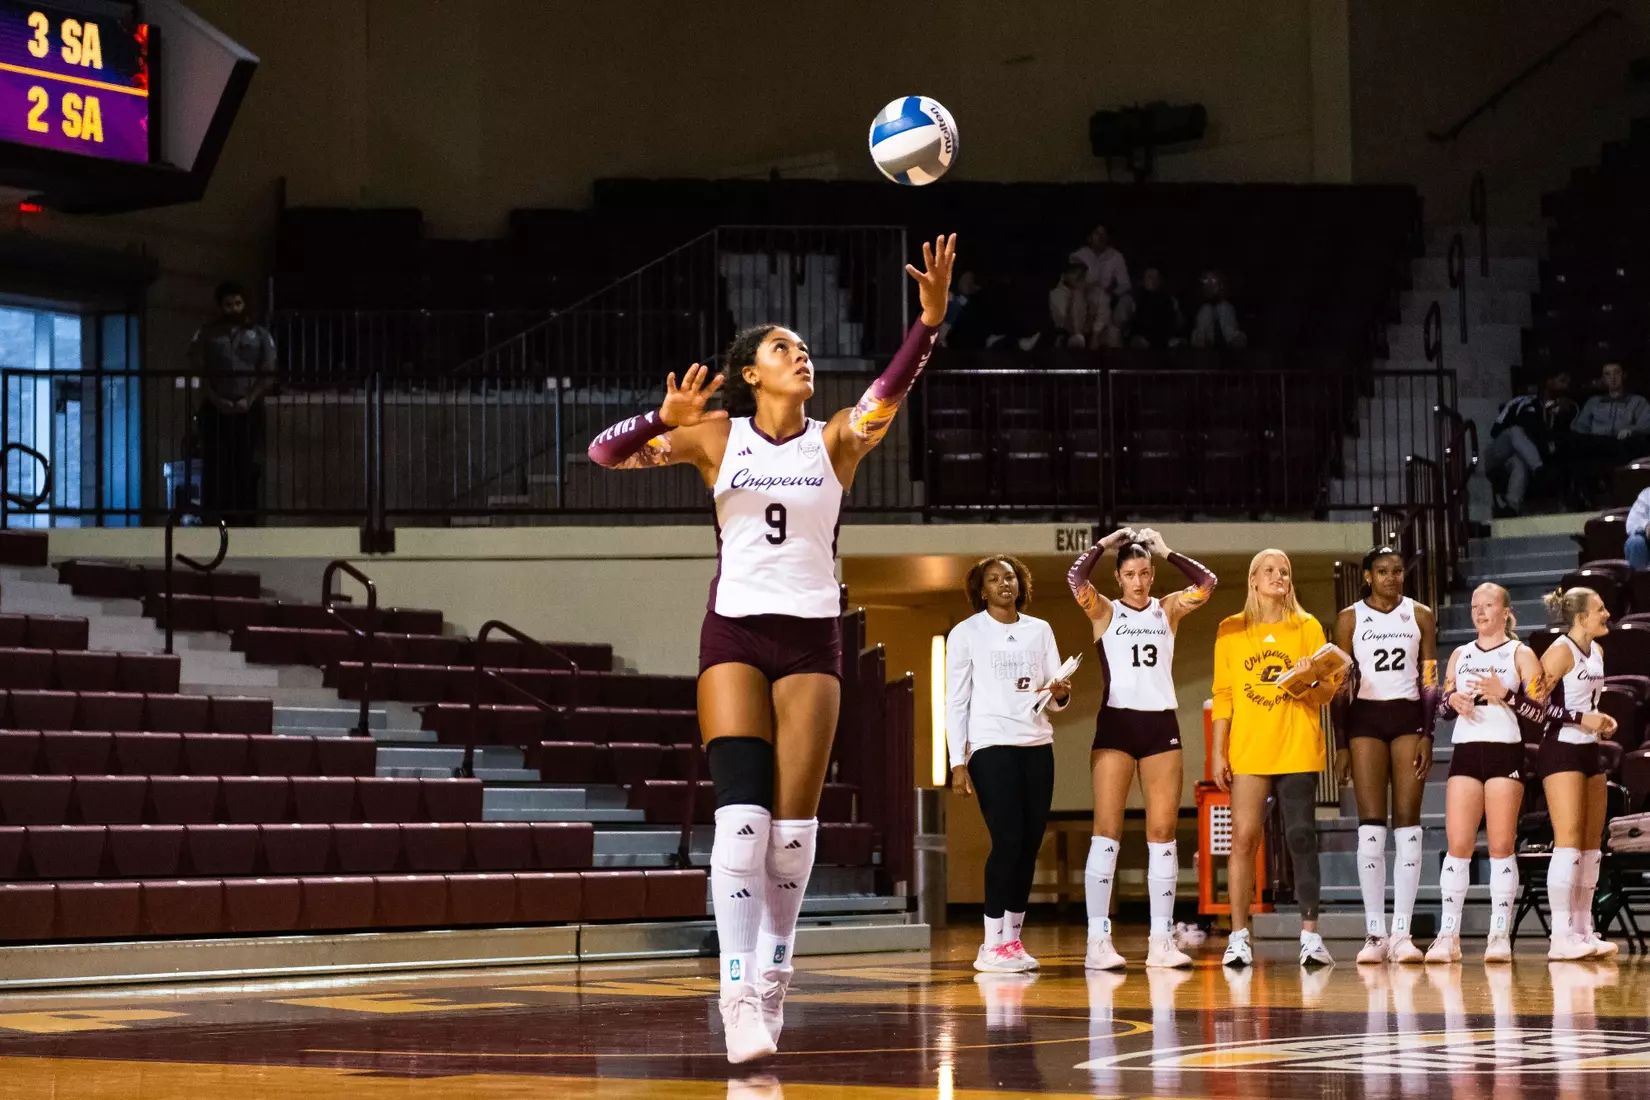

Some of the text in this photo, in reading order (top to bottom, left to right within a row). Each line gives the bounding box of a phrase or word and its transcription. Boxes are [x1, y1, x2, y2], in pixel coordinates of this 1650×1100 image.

[27, 11, 103, 70] 3 SA
[27, 86, 103, 142] 2 SA
[930, 107, 952, 154] molten
[730, 467, 824, 491] Chippewas
[765, 503, 787, 545] 9
[1056, 528, 1088, 551] EXIT
[1115, 624, 1167, 637] Chippewas
[1131, 643, 1158, 668] 13
[1373, 647, 1406, 672] 22
